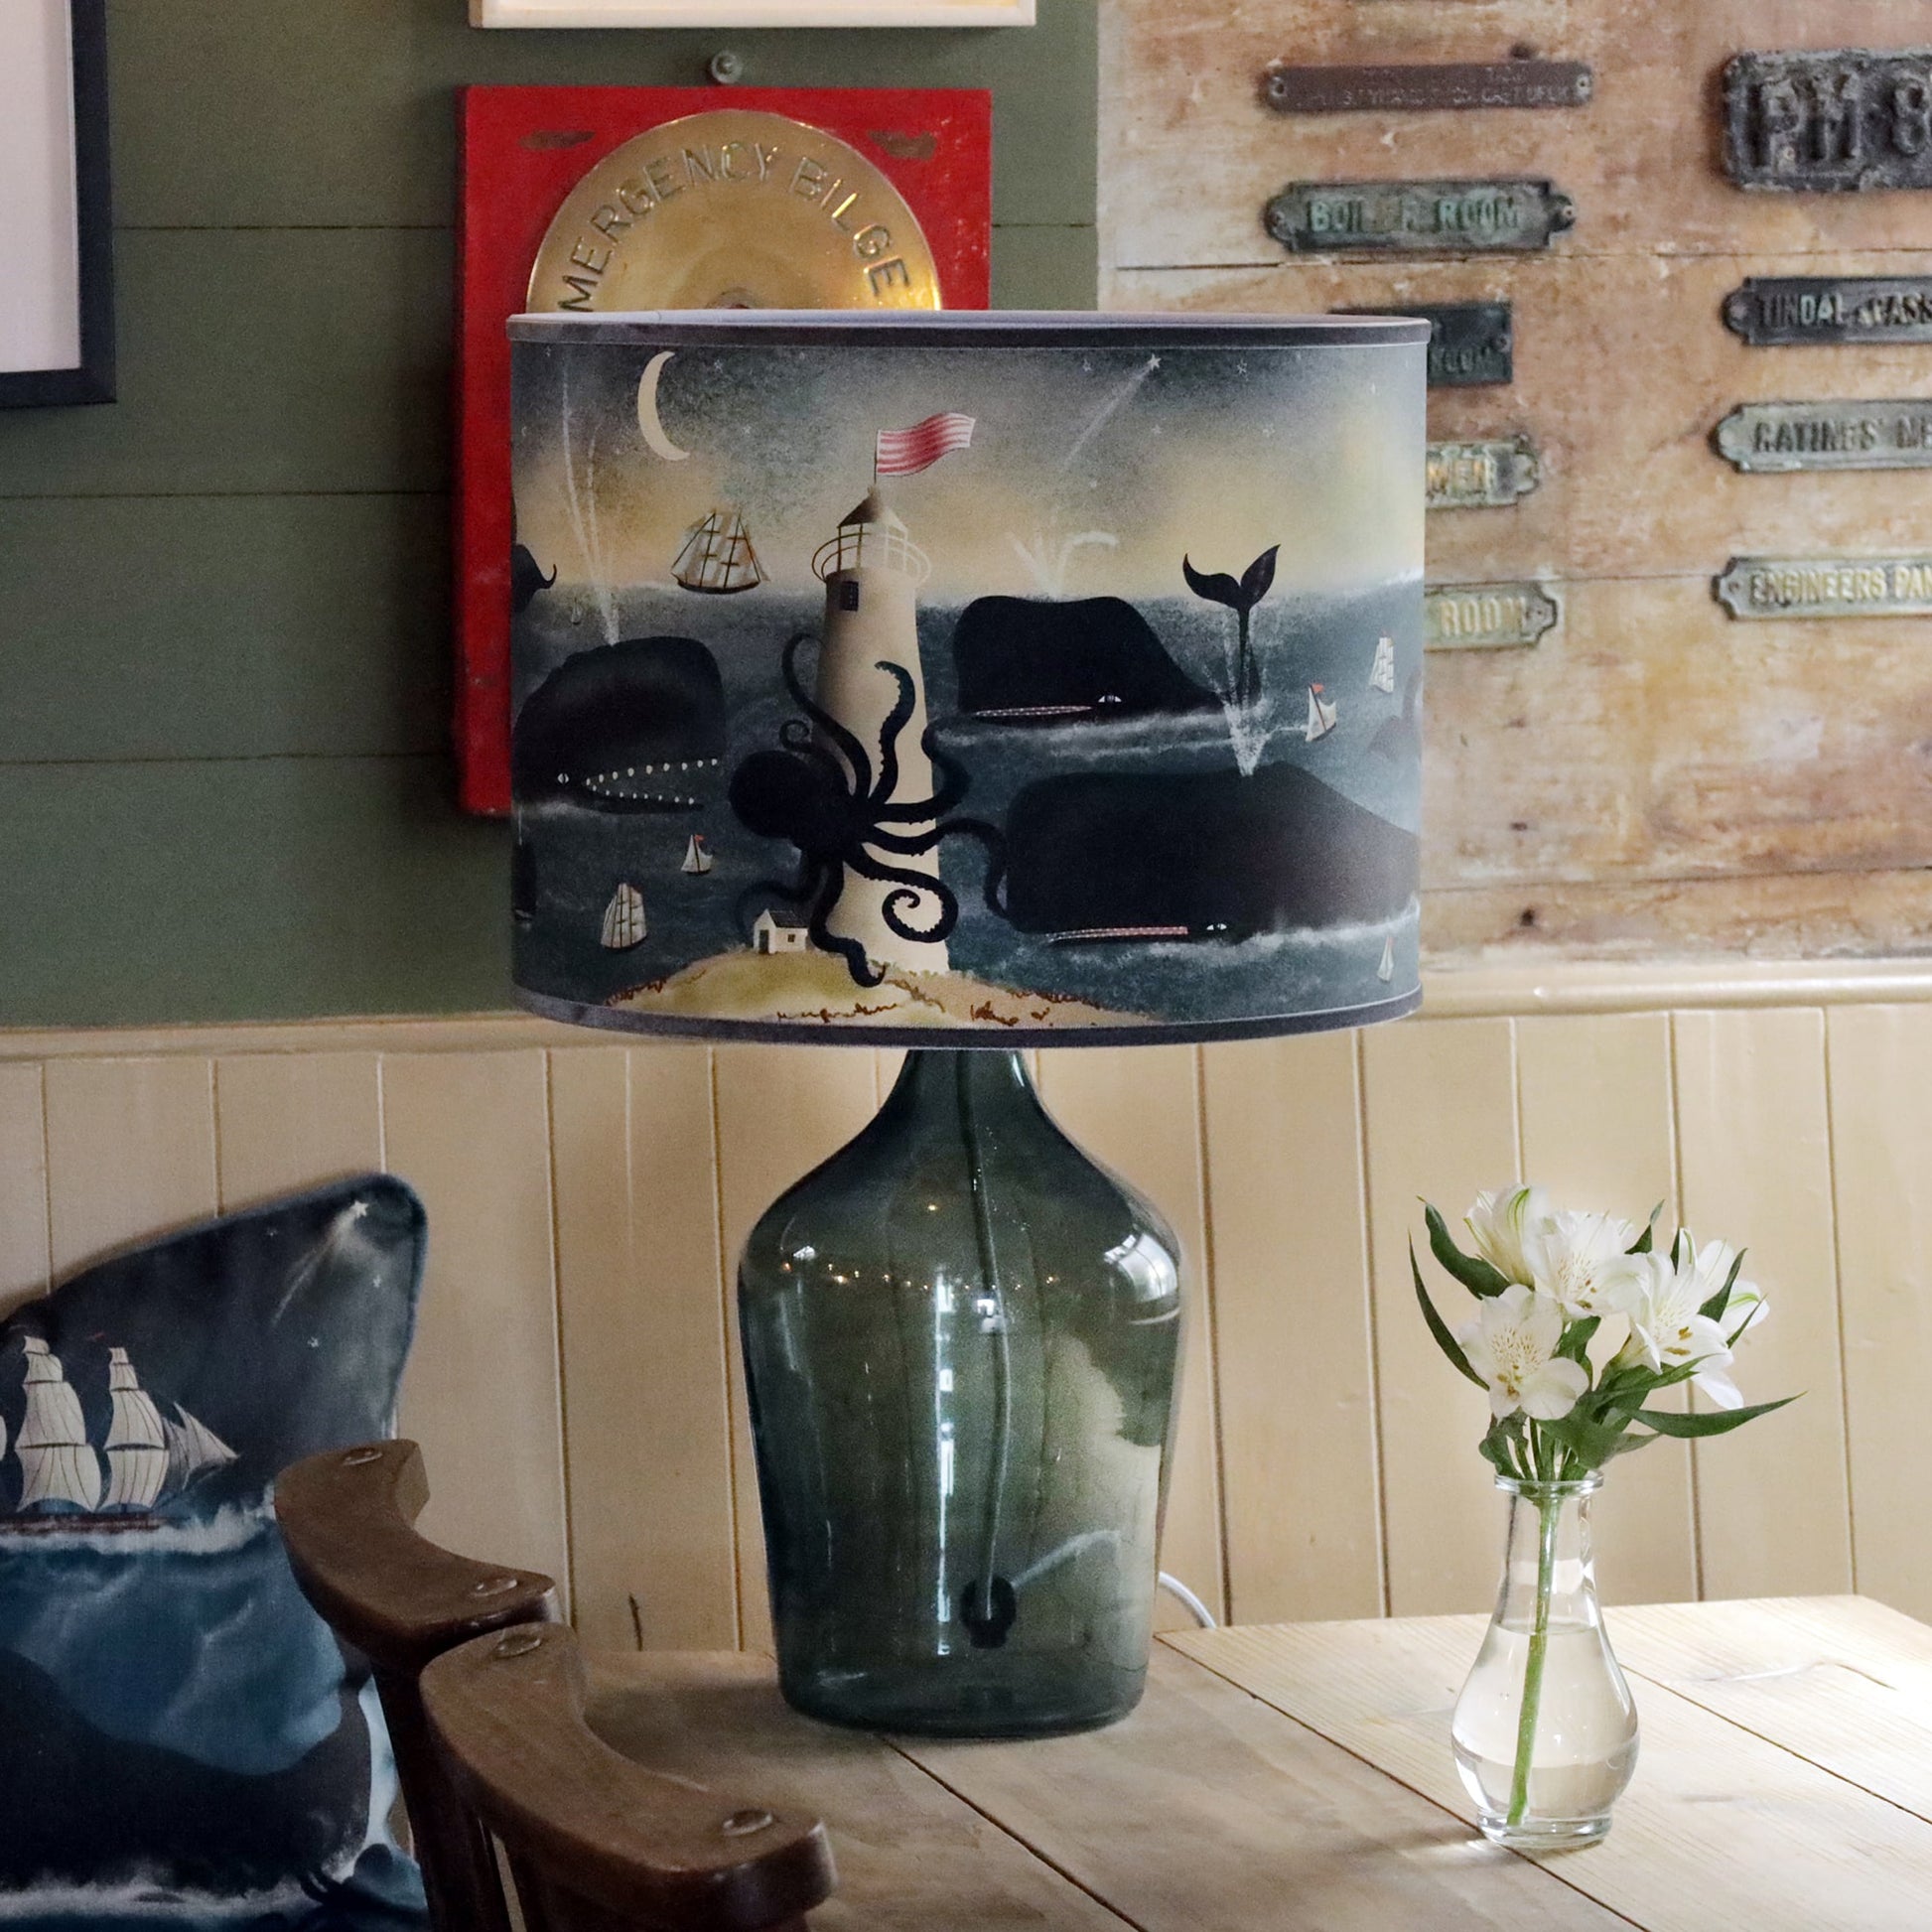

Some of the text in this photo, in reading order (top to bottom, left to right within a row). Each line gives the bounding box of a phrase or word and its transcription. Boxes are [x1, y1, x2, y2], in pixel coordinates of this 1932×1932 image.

[791, 155, 911, 296] BILGE
[1310, 197, 1522, 233] BOIR ROOM
[1749, 568, 1886, 604] ENGINEERS
